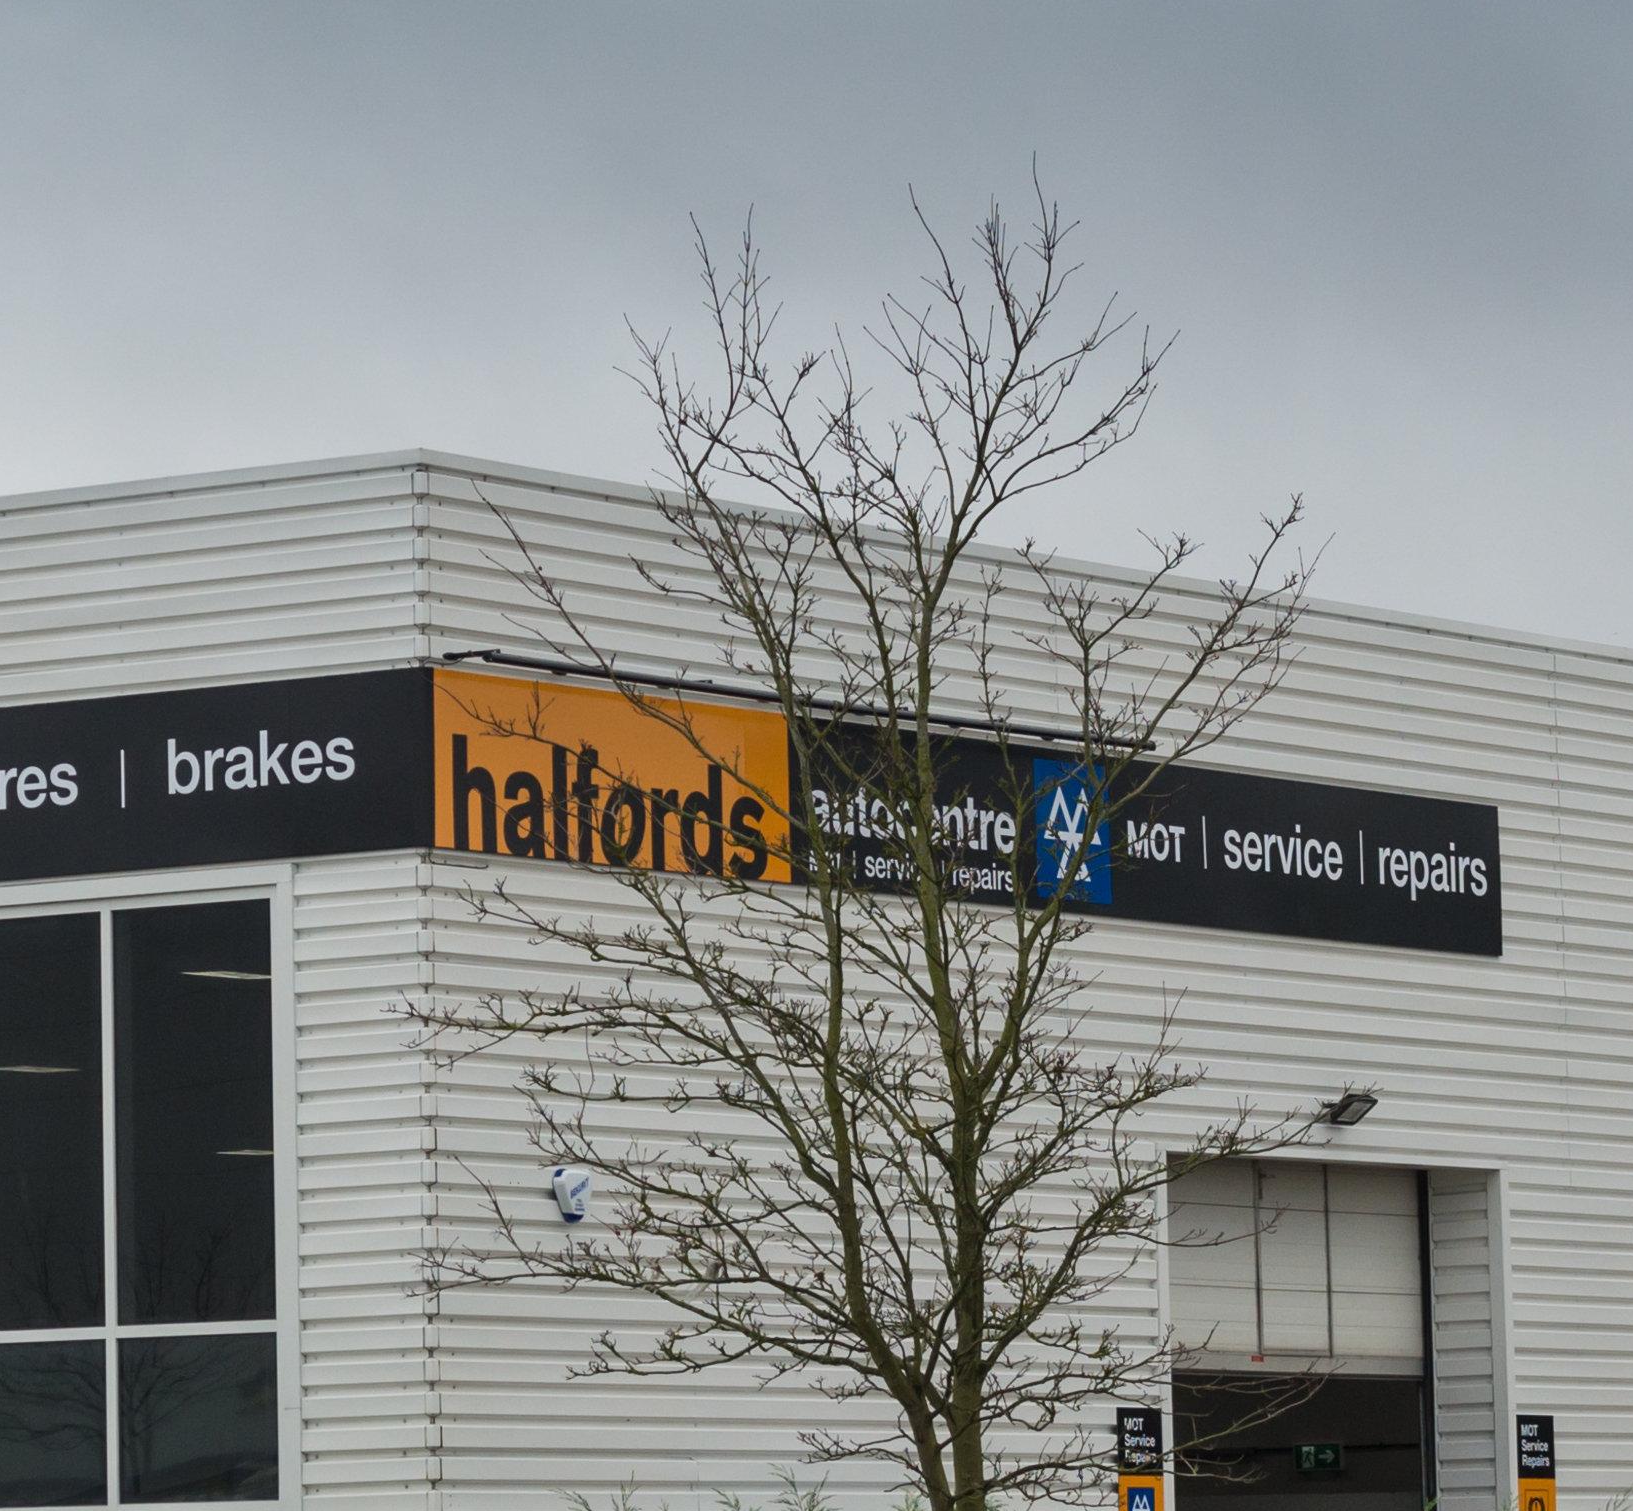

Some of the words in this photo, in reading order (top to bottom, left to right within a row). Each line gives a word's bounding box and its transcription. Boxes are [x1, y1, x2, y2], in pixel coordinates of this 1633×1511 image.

[166, 729, 356, 795] brakes
[452, 733, 769, 881] halfords
[1126, 819, 1186, 864] MOT
[1223, 824, 1344, 882] service
[1378, 840, 1488, 902] repairs
[1123, 1417, 1145, 1431] MOT
[1520, 1424, 1539, 1437] MOT
[1123, 1433, 1156, 1447] Service
[1520, 1439, 1549, 1452] Service
[1521, 1454, 1551, 1468] Repairs
